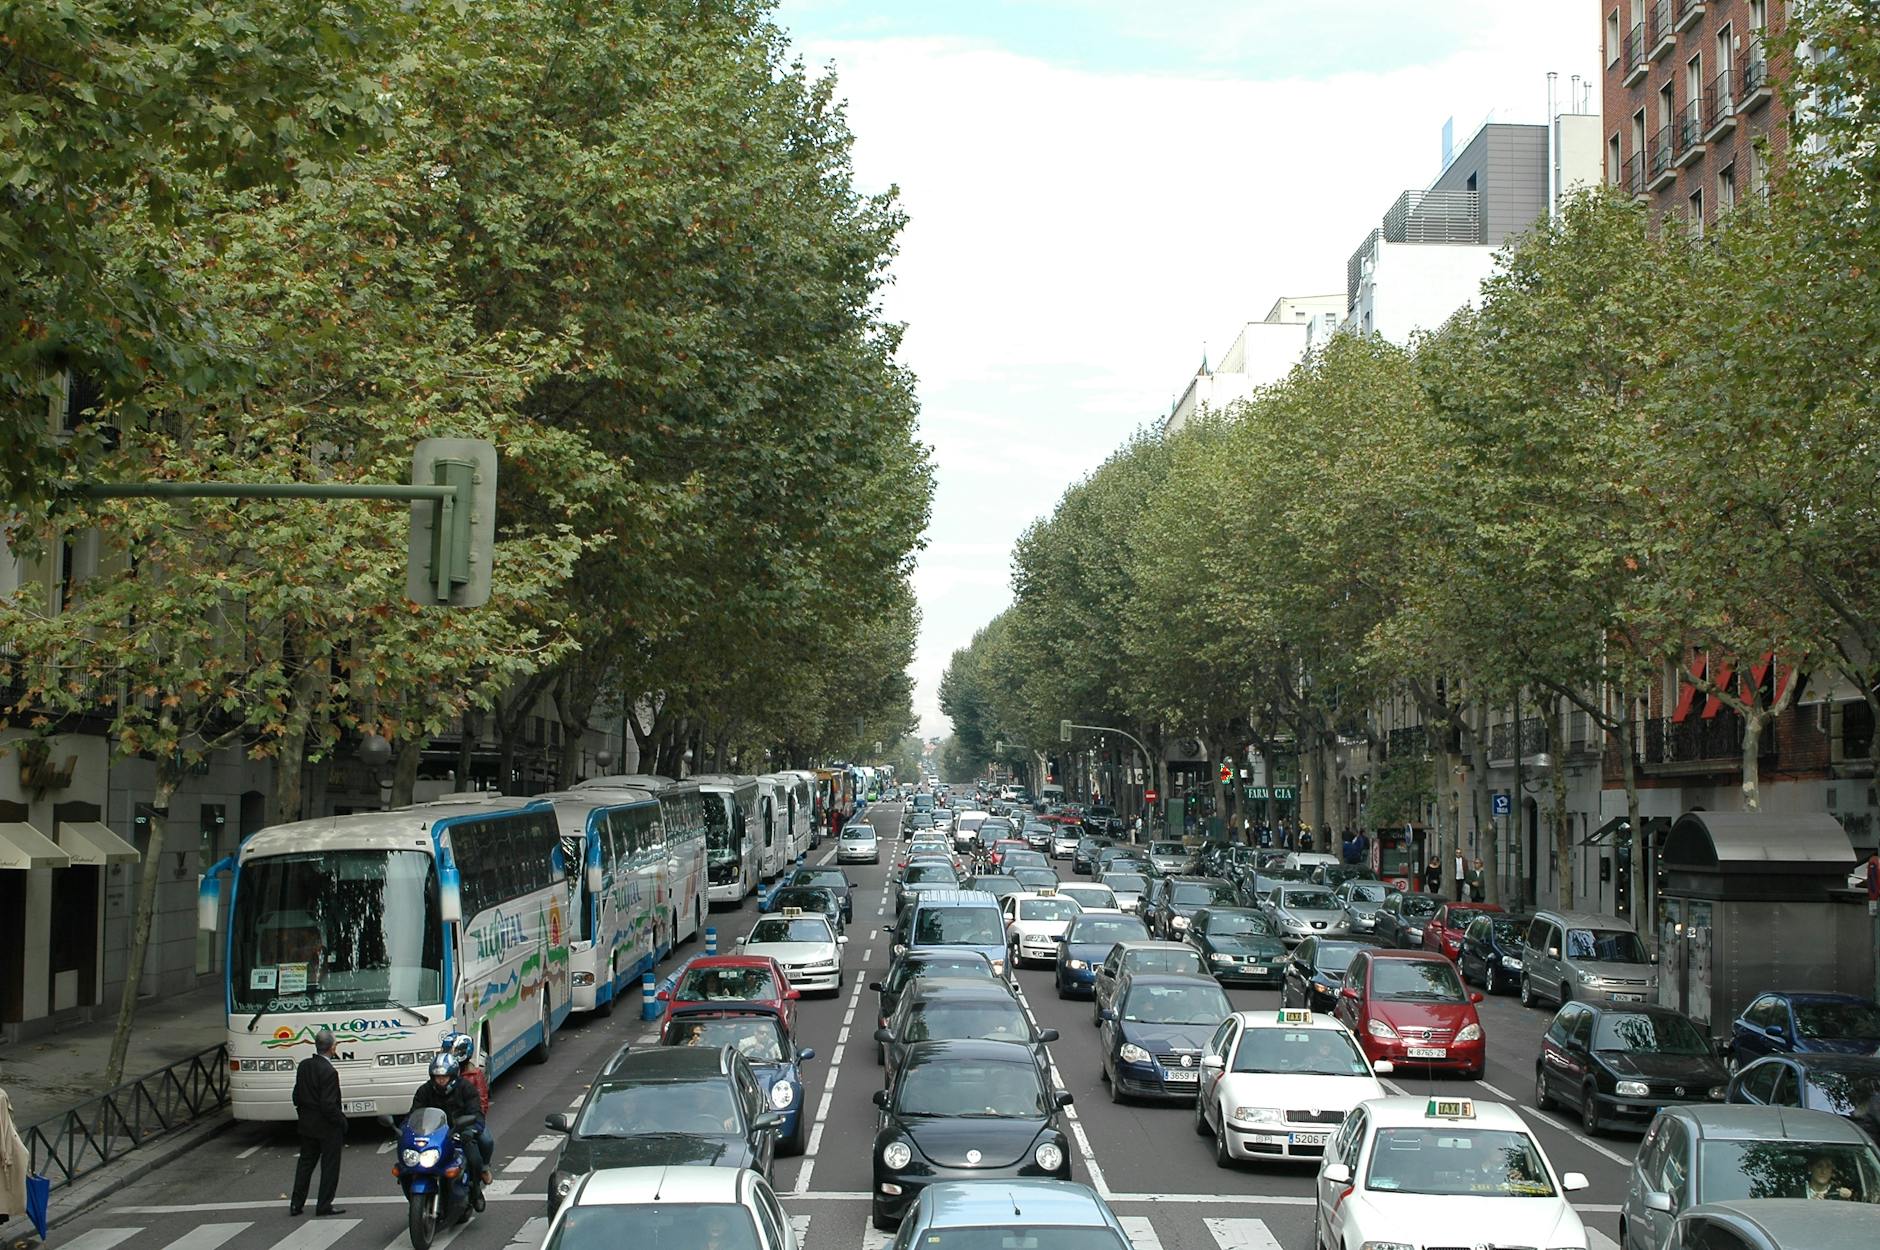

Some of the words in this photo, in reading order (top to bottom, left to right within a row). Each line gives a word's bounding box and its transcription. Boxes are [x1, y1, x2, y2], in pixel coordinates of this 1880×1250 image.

[1248, 788, 1292, 799] FARMCIA
[319, 1017, 402, 1033] ALCOTAN
[1439, 1102, 1460, 1115] TAXI
[1295, 1134, 1319, 1144] 5206
